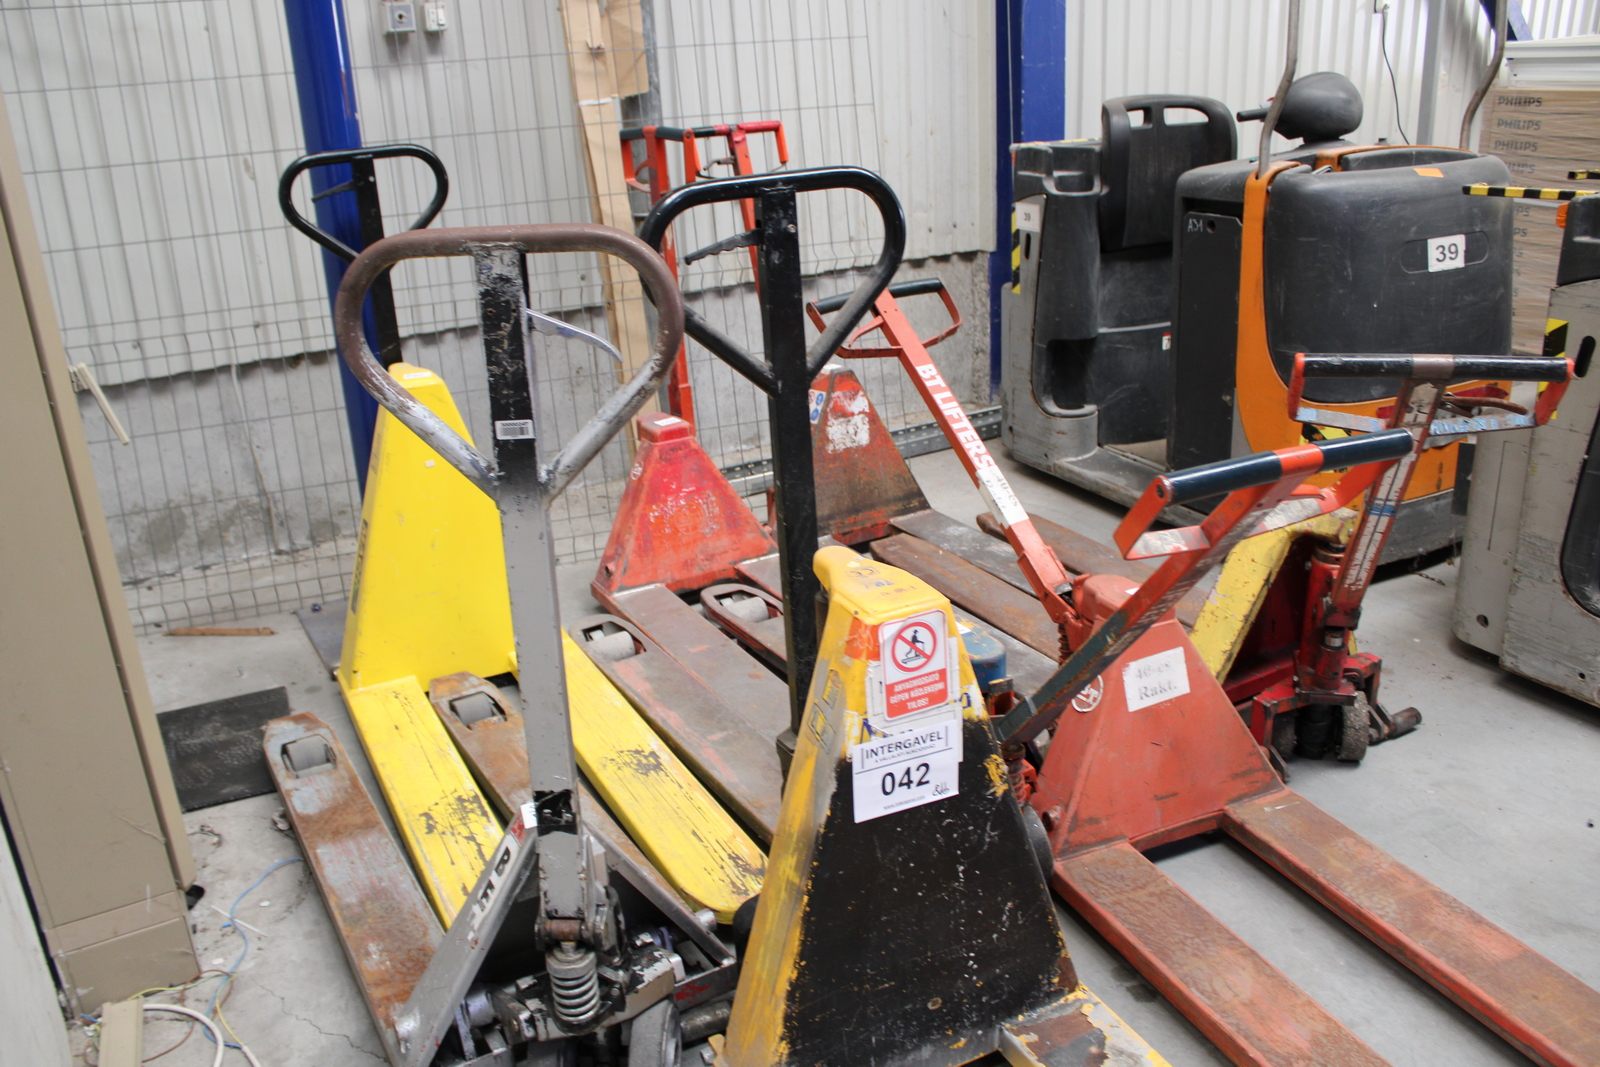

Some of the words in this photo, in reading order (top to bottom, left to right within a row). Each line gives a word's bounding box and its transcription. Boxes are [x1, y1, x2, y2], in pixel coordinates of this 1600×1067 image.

[1497, 95, 1543, 107] PHILIPS
[1497, 118, 1541, 131] PHILIPS
[1494, 140, 1539, 152] PHILIPS
[1435, 242, 1459, 263] 39
[916, 364, 945, 388] BT
[934, 390, 995, 470] LIFTERS
[906, 697, 929, 710] TILOS!
[865, 730, 943, 759] INTERGAVEL
[881, 762, 930, 796] 042
